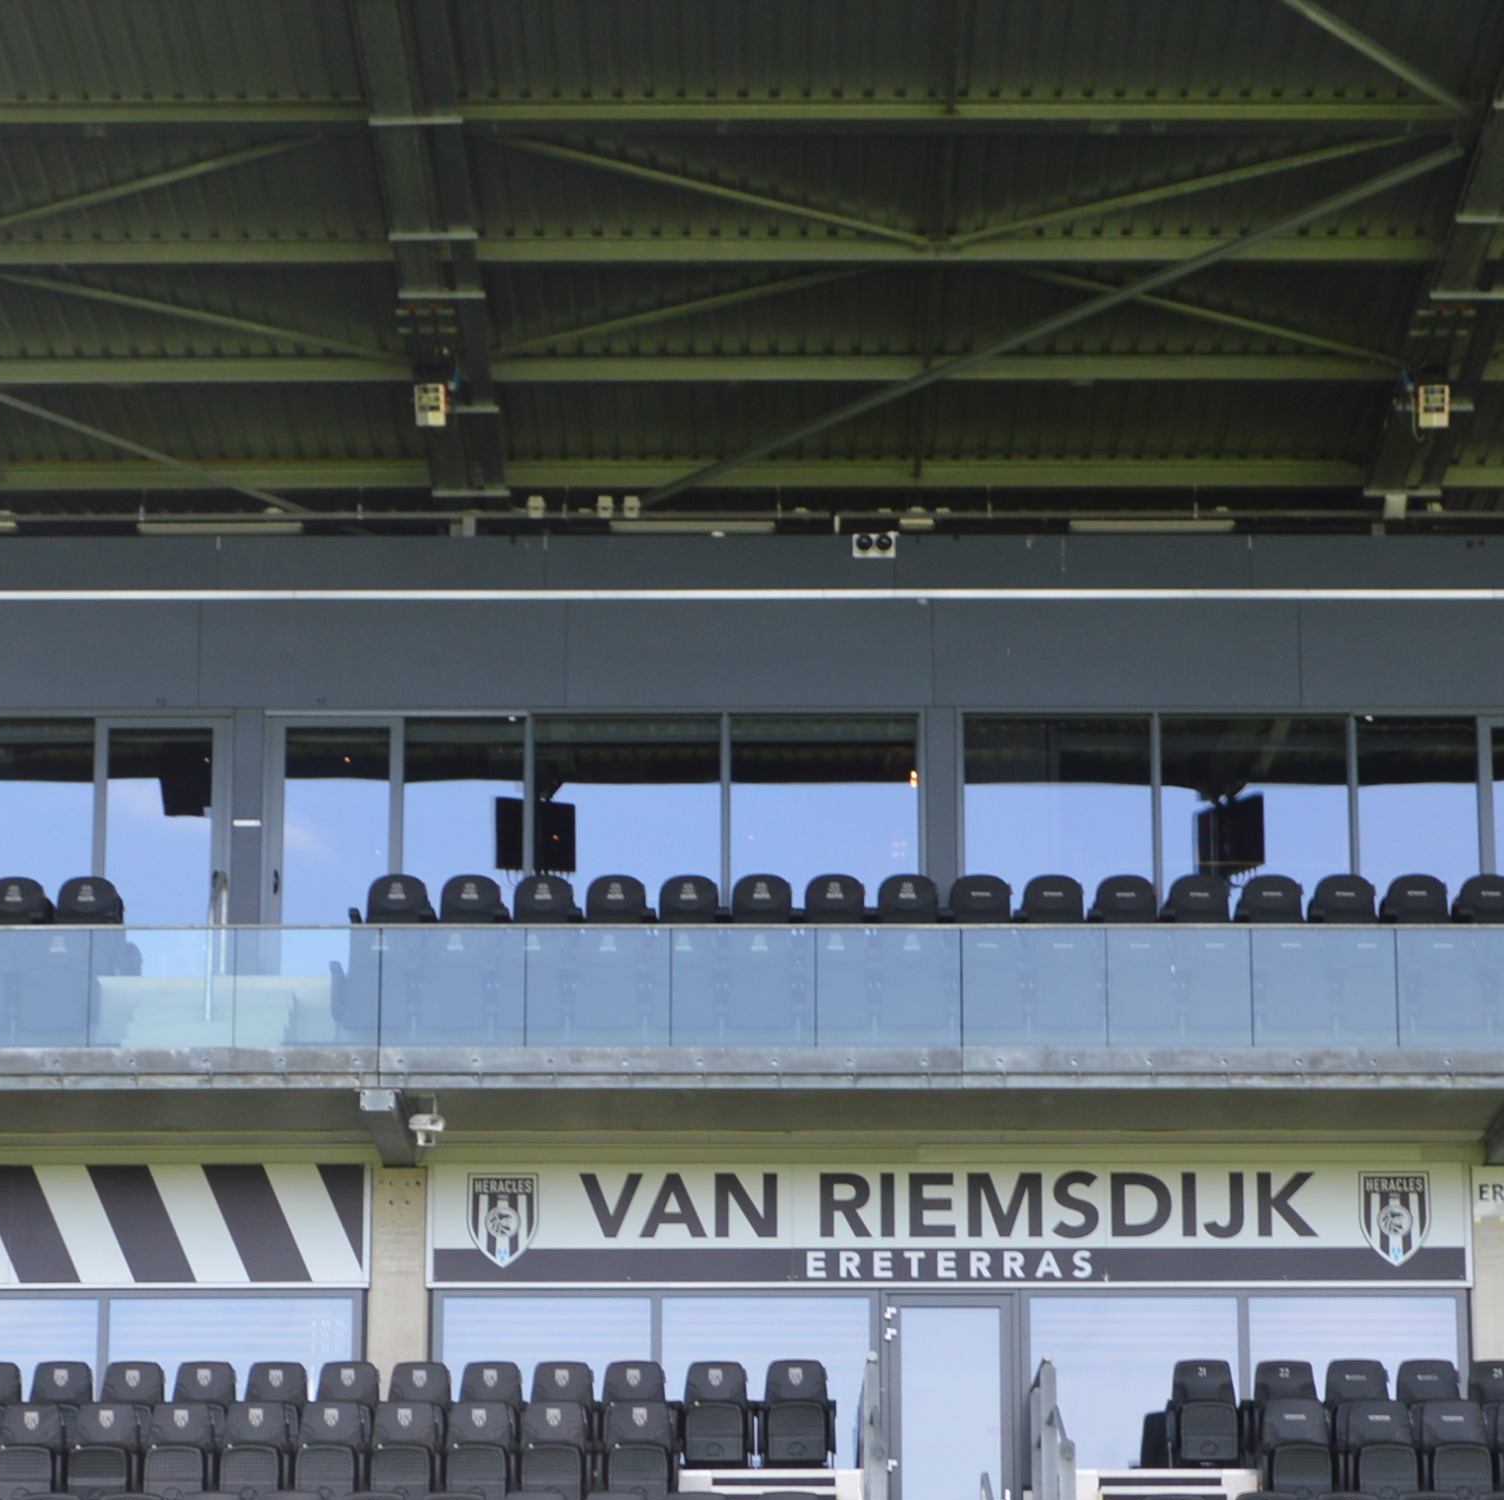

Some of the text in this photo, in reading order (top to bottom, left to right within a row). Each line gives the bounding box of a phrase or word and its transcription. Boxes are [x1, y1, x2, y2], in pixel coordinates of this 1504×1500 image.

[475, 1179, 532, 1194] HERACLES
[1365, 1177, 1424, 1192] HERACLES
[580, 1171, 1318, 1238] VAN RIEMSDIJK
[806, 1250, 1095, 1280] ERETERRAS
